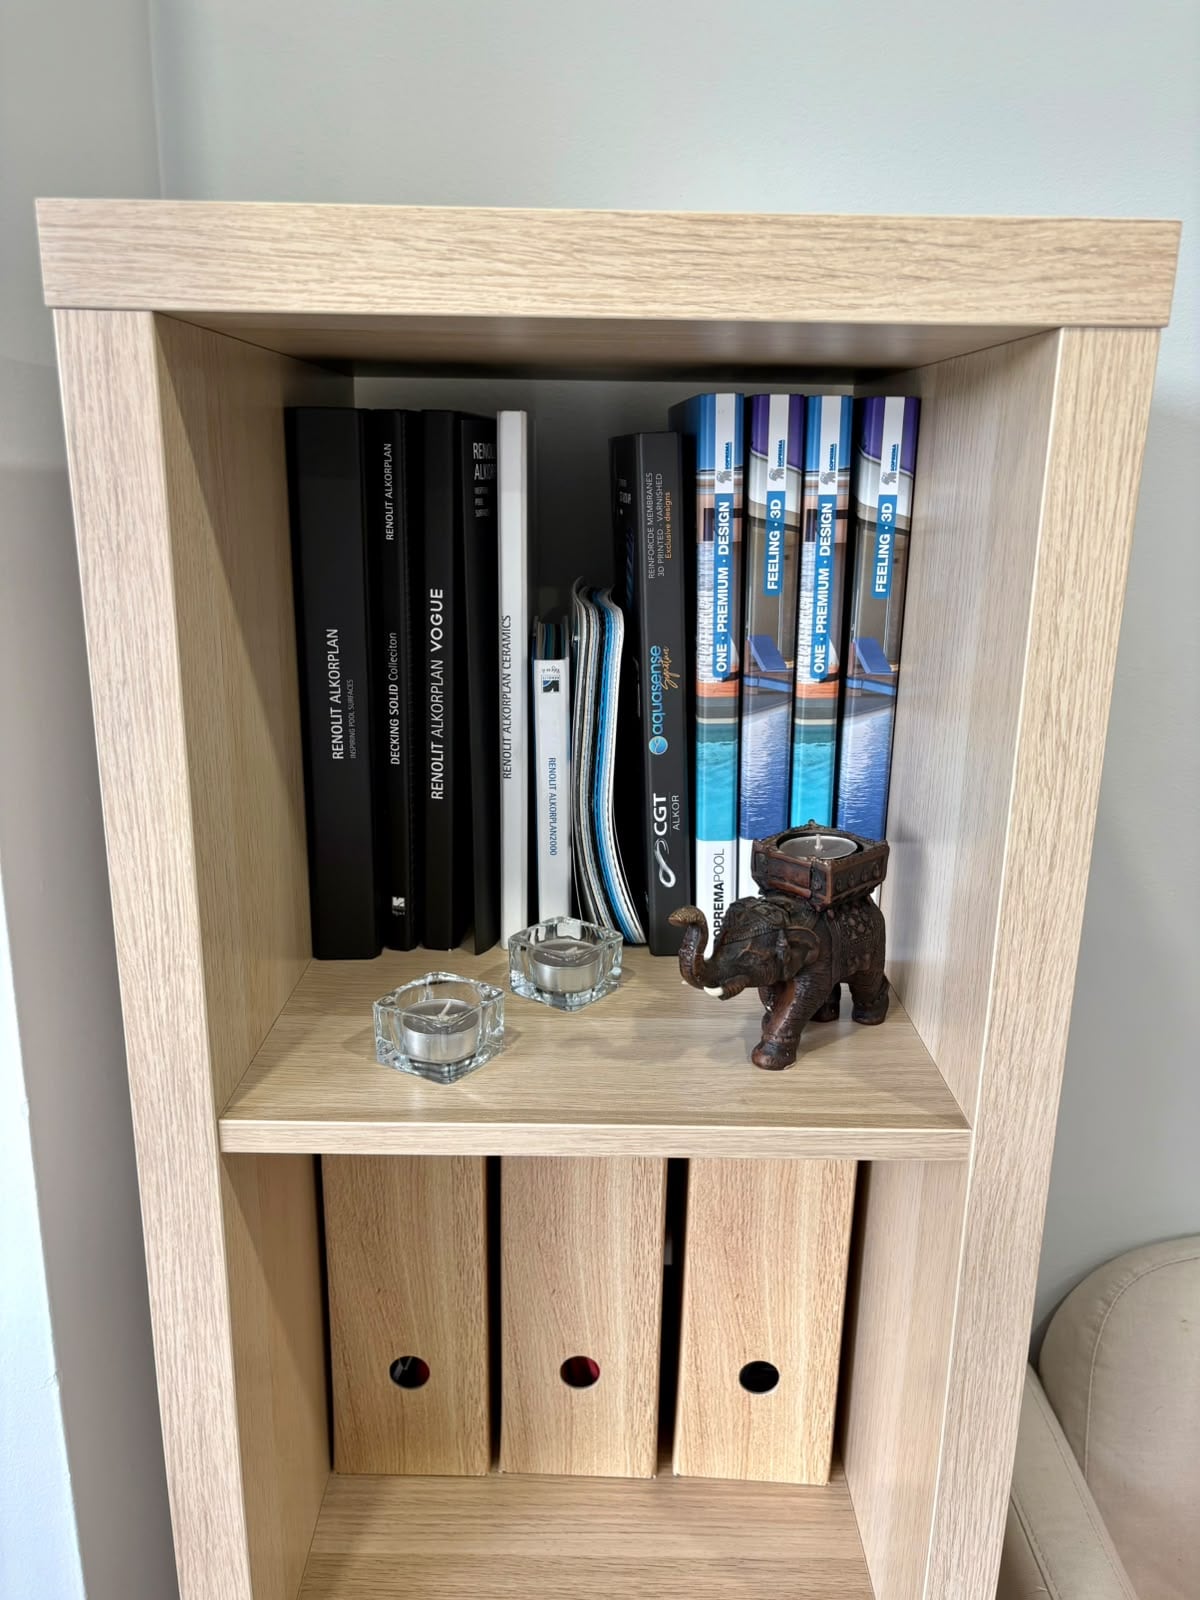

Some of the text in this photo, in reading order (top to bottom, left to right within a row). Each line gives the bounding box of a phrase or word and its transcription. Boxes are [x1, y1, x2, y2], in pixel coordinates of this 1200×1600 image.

[384, 444, 394, 540] RENOLIT ALKORPLAN
[646, 473, 654, 525] MEMBRANES
[664, 492, 672, 521] designs
[658, 566, 664, 576] 3D
[717, 502, 730, 672] ONE PREMIUM DESIGN
[767, 499, 781, 589] FEELING 3D
[814, 503, 832, 673] ONE PREMIUM DESIGN
[876, 503, 893, 592] FEELING 3D
[327, 629, 344, 759] RENOLIT ALKORPLAN
[389, 684, 399, 715] SOLID
[430, 588, 444, 799] RENOLIT ALKORPLAN VOGUE
[501, 615, 512, 779] RENOLIT ALKORPLAN CERAMICS
[651, 646, 668, 734] aquasense
[390, 719, 400, 765] DECKING
[548, 758, 557, 855] RENOLIT ALKORPLAN2000
[654, 793, 667, 836] CGT
[672, 795, 680, 830] ALKOR
[713, 849, 724, 937] OPREMAPOOL
